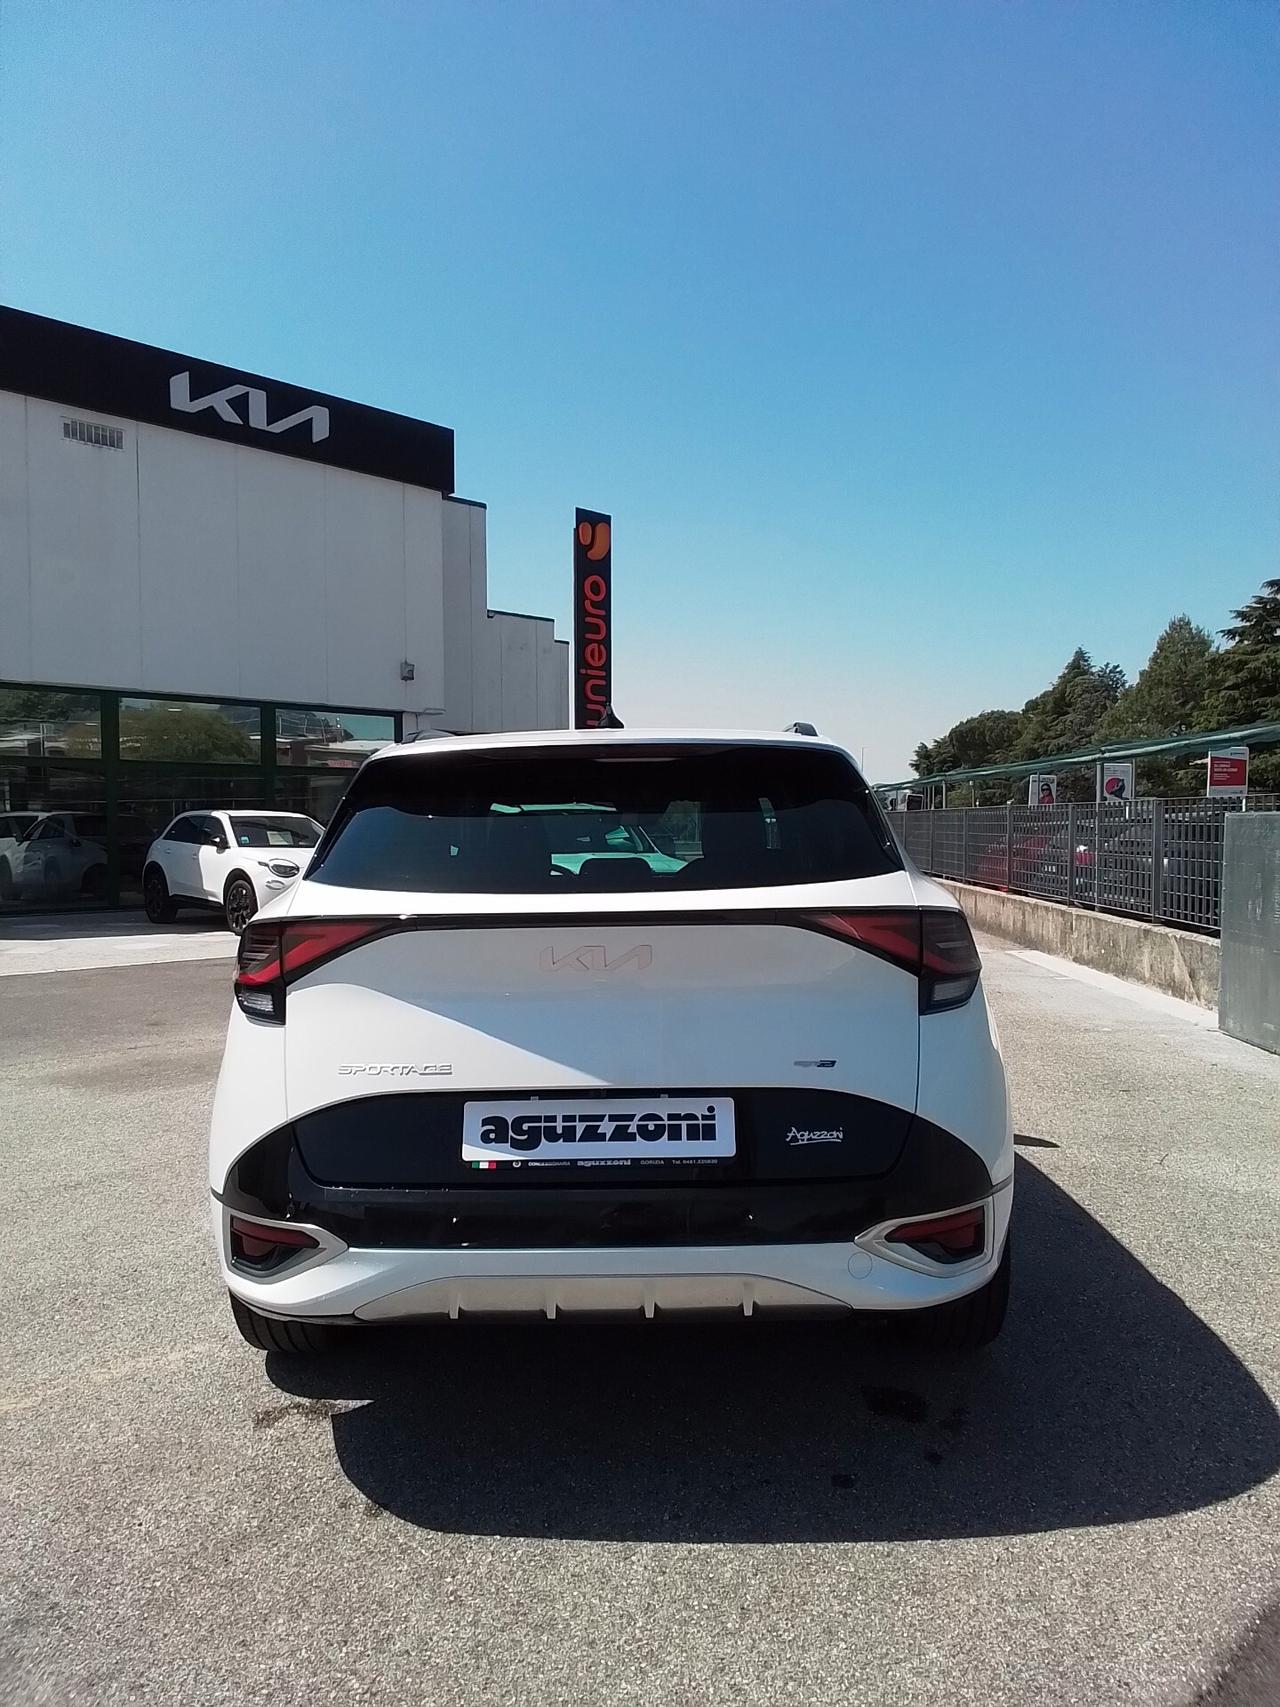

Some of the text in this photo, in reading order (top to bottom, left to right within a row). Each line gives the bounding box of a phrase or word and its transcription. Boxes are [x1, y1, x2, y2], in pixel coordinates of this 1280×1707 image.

[169, 371, 330, 443] KIA
[579, 574, 607, 726] unieuro
[338, 1064, 452, 1076] SPORTAGE
[479, 1104, 717, 1151] aguzzoni
